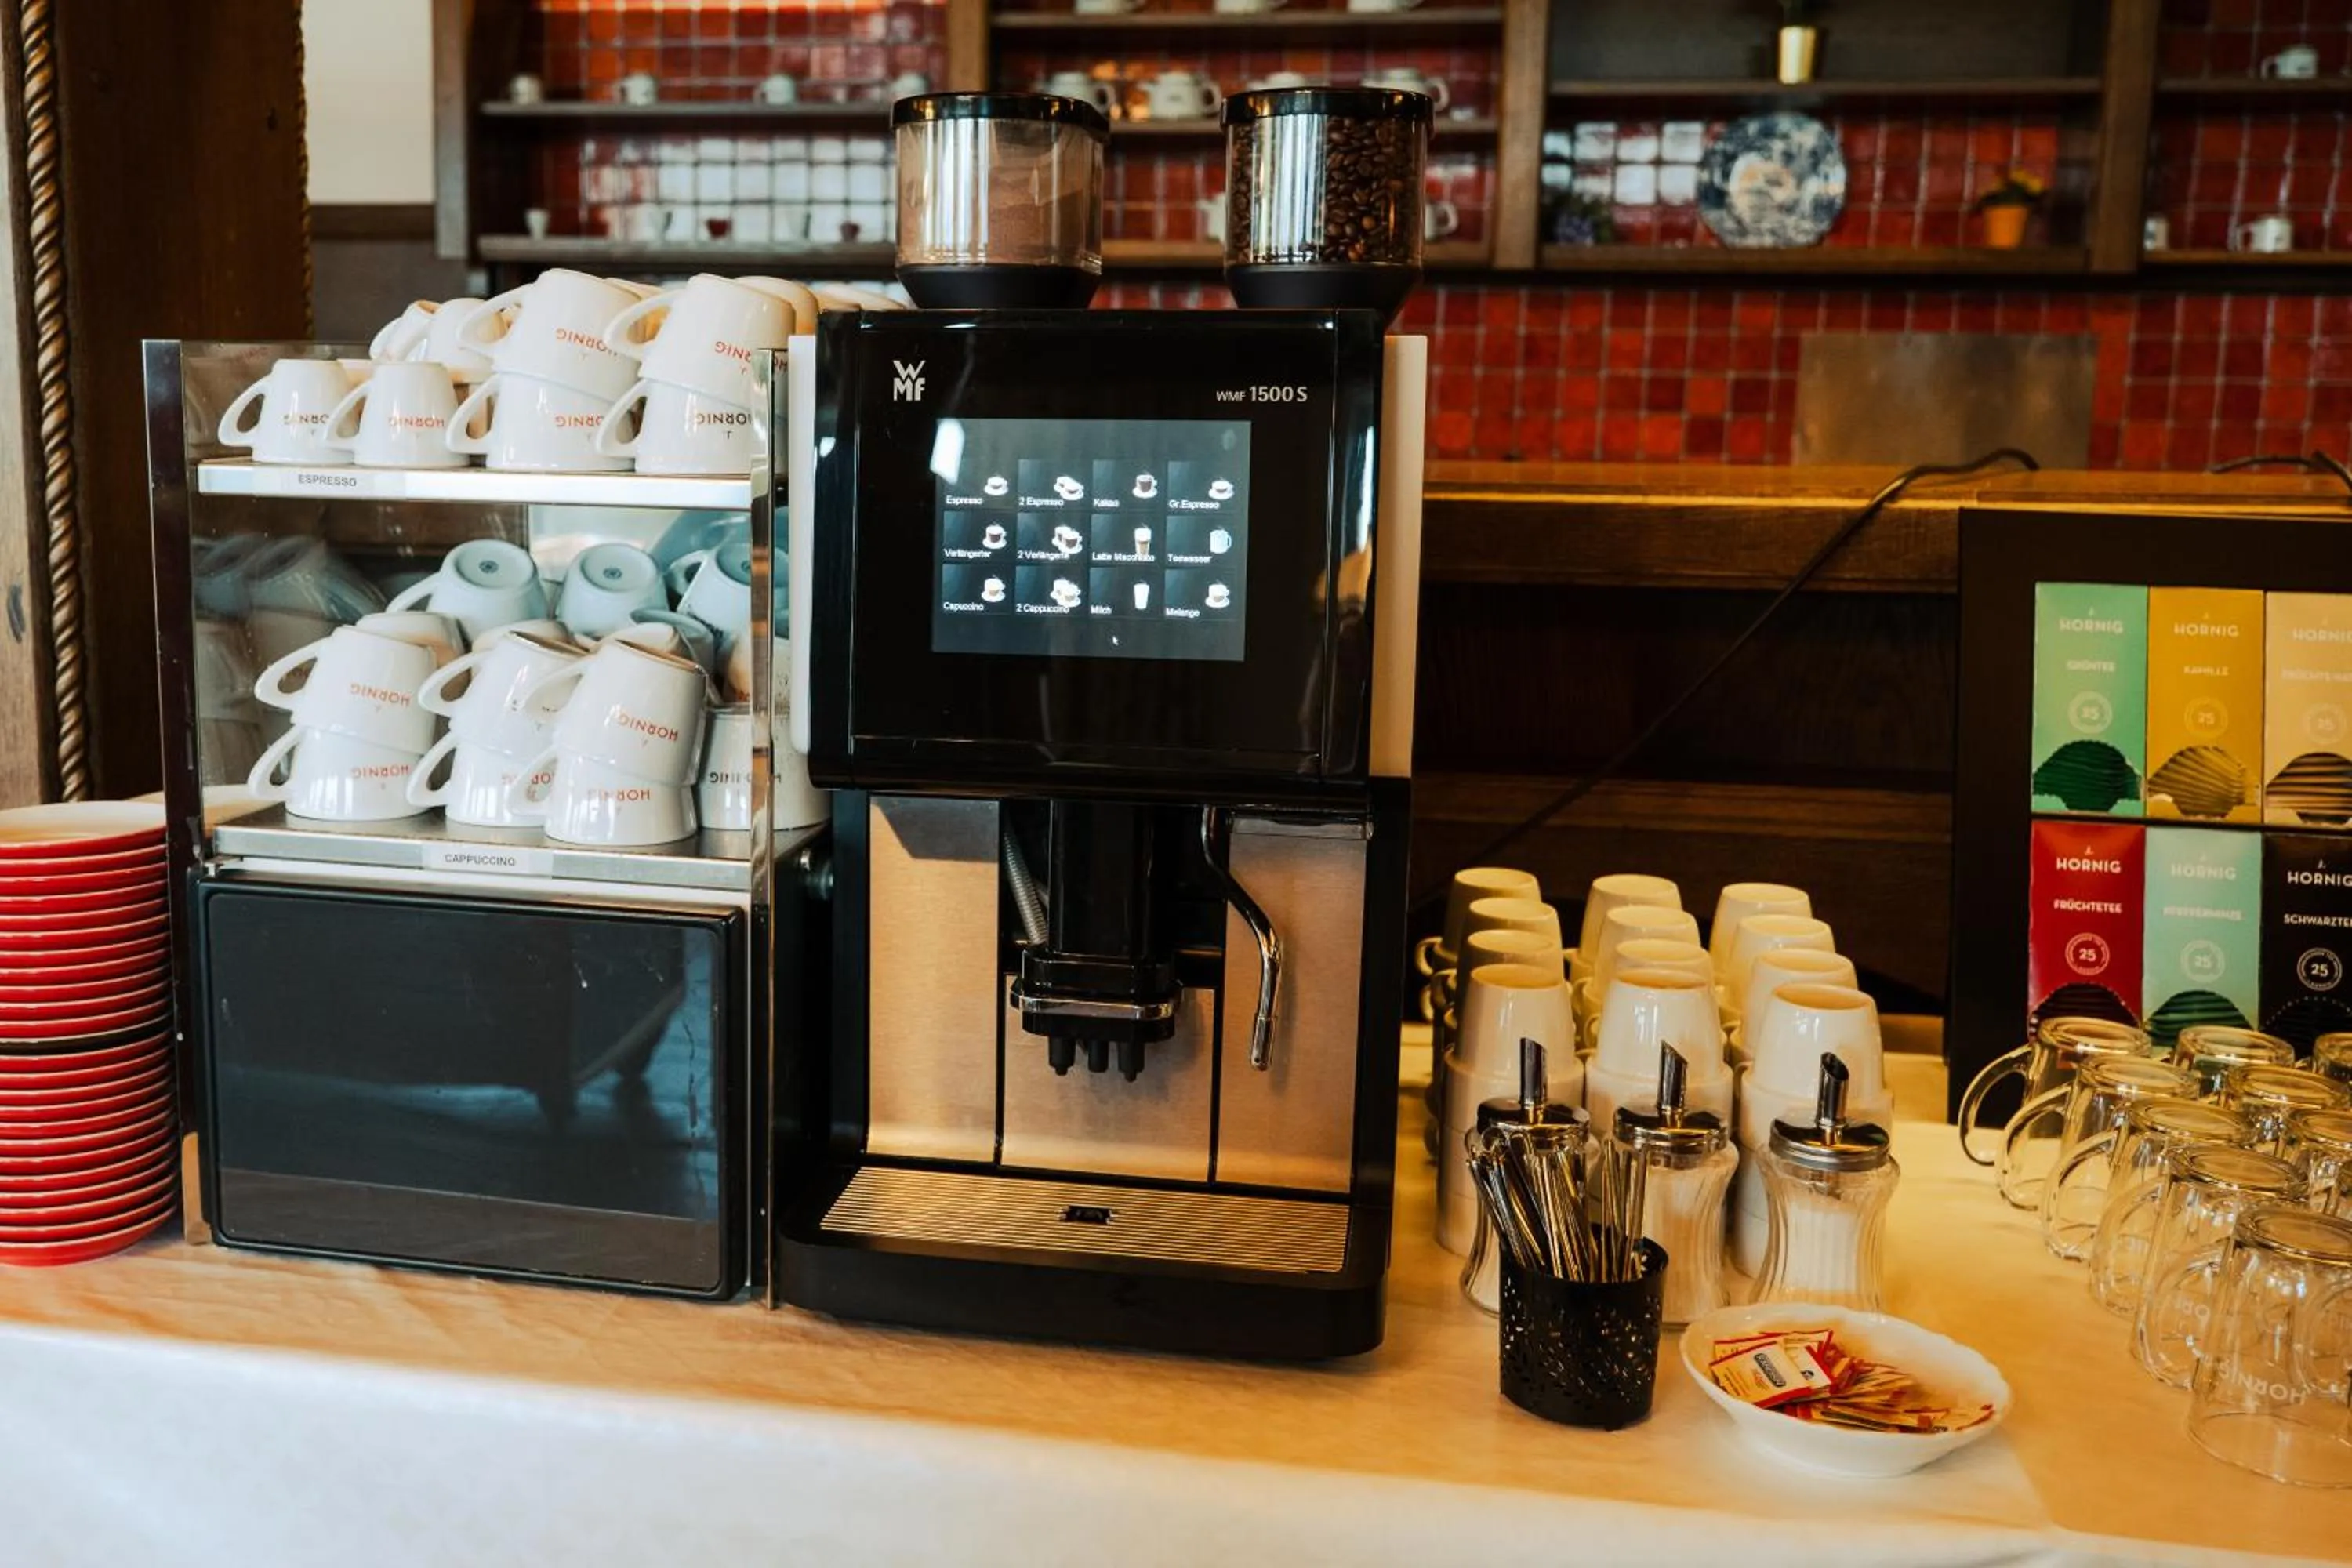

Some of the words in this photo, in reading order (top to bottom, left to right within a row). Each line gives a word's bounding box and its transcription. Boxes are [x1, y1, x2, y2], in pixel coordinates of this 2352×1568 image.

[556, 328, 616, 355] ORNIG
[893, 360, 927, 401] WMF
[1216, 390, 1246, 402] WMF
[554, 416, 604, 428] ORNIG
[298, 474, 357, 487] ESPRESSO
[946, 495, 982, 506] Espresso
[1026, 497, 1064, 507] Espresso
[2059, 619, 2124, 634] HORNIG
[2174, 623, 2239, 638] HORNIG
[350, 684, 412, 707] HORNIG
[616, 712, 679, 742] HORNIG
[350, 764, 411, 780] HORNIG
[445, 852, 516, 867] CAPPUCCINO
[2056, 857, 2122, 873] HORNIG
[2171, 864, 2237, 880] HORNIG
[2287, 870, 2352, 887] HORNIG
[2053, 898, 2122, 913] FRÜCHTETEE
[2284, 913, 2352, 928] SCHWARZTE
[2079, 948, 2096, 962] 25
[2310, 963, 2329, 978] 25
